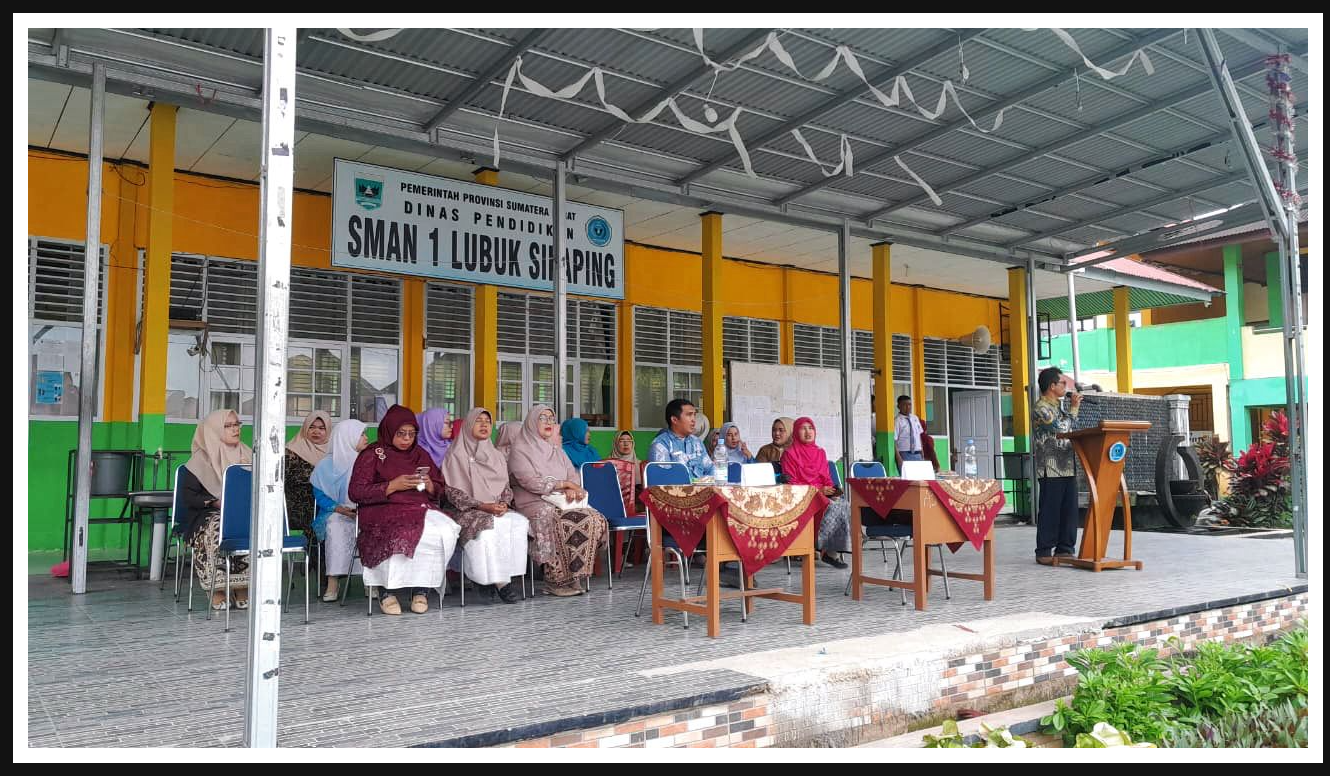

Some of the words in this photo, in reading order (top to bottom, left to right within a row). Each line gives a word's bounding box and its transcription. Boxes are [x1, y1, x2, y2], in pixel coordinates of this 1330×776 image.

[400, 182, 460, 201] PEMERINTAH
[462, 192, 504, 209] PROVINSI
[506, 200, 550, 217] SUMATERA
[404, 200, 460, 222] DINAS
[473, 211, 574, 241] PENDIDIKN
[347, 214, 418, 265] SMAN
[428, 227, 439, 267] 1
[451, 230, 522, 278] LUBUK
